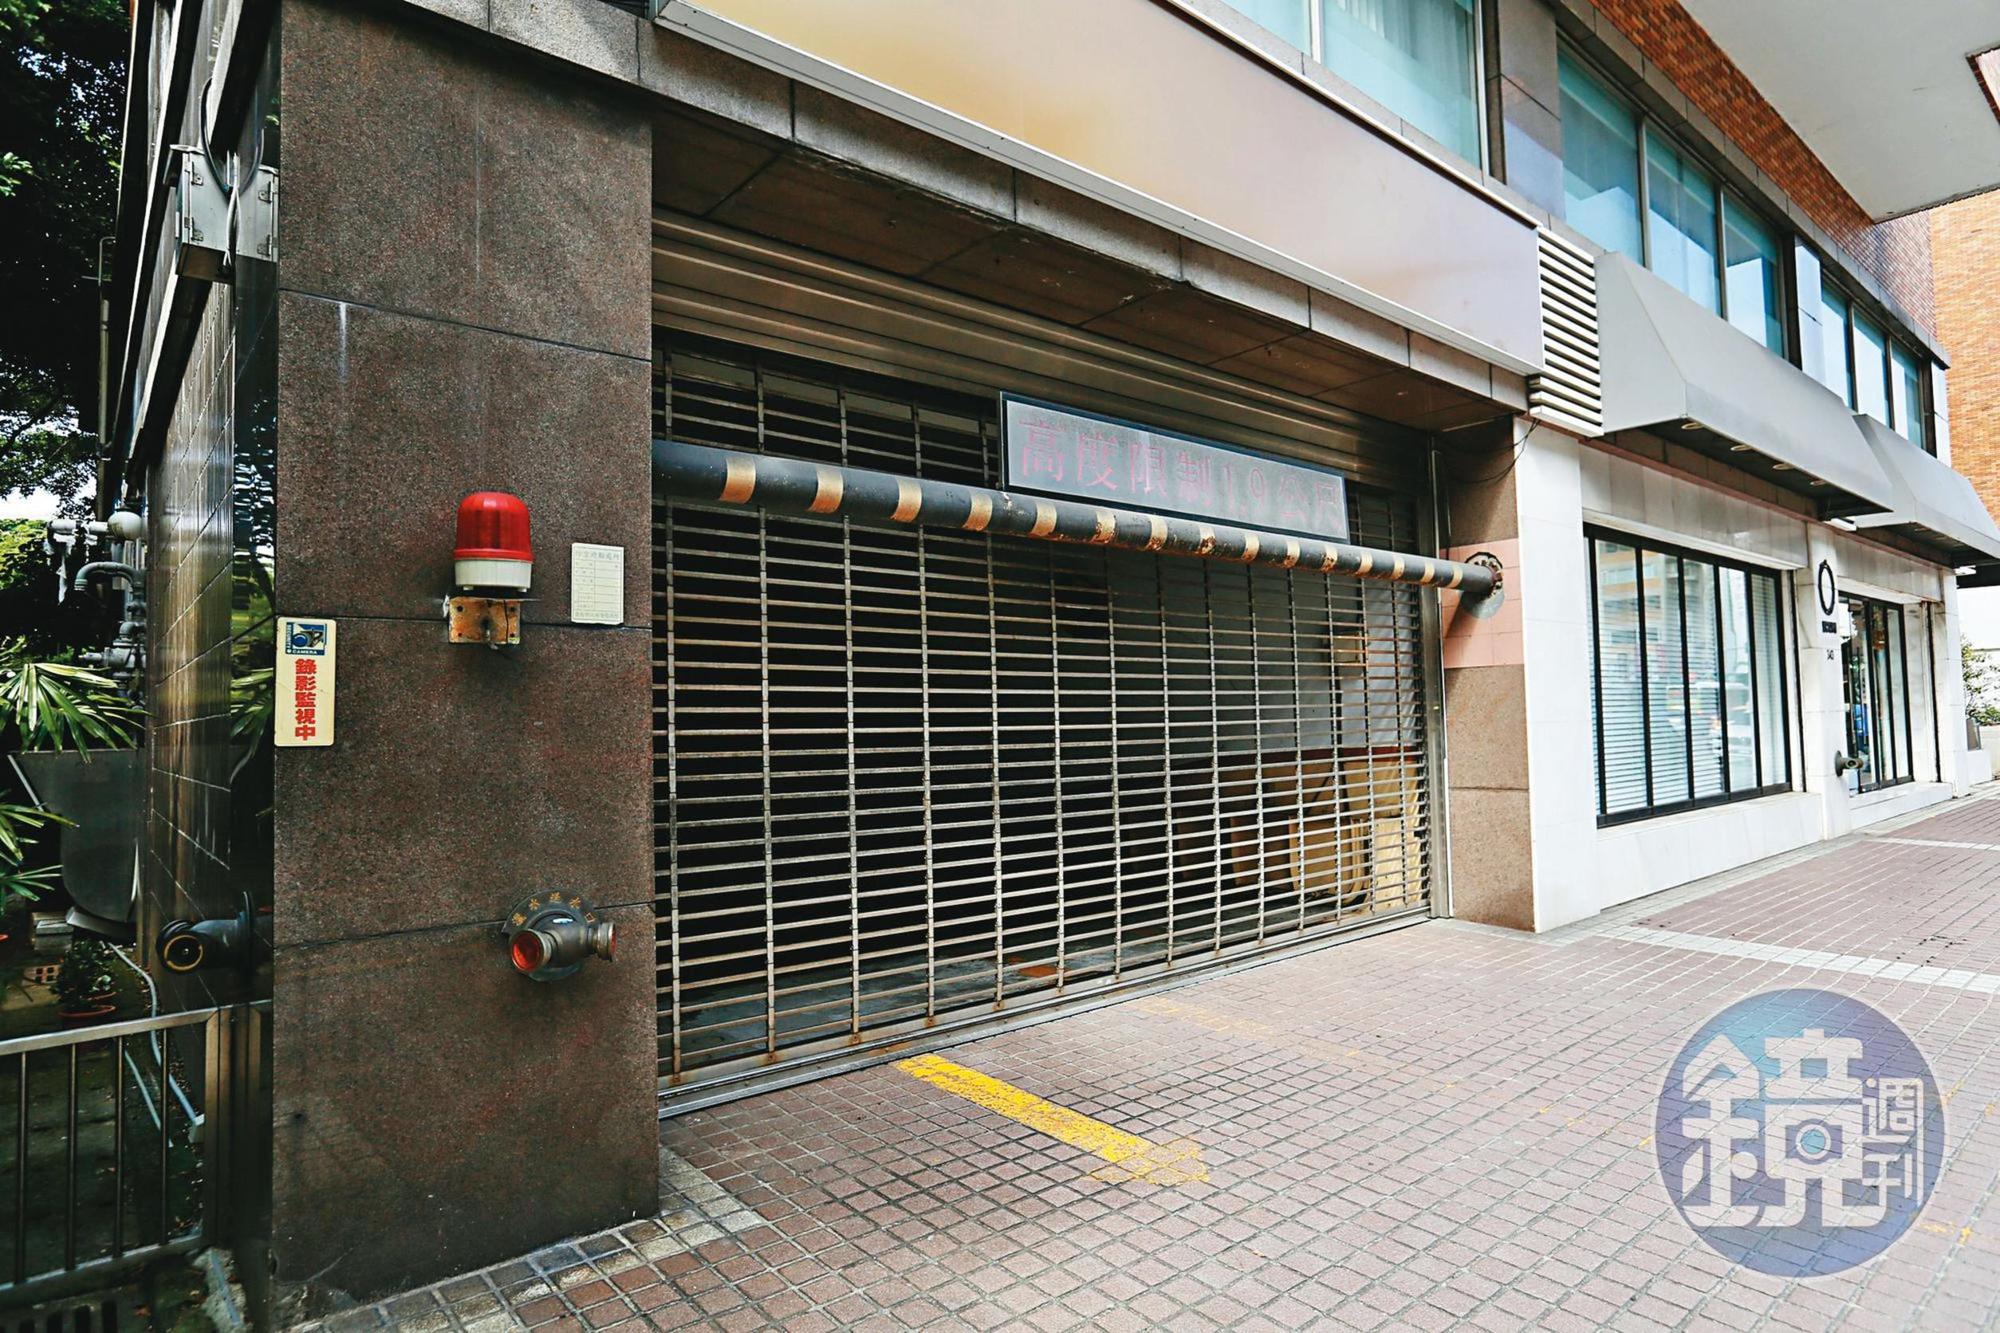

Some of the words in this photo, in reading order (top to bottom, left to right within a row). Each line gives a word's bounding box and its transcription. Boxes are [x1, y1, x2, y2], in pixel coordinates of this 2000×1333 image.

[294, 658, 317, 741] 錄影監視中
